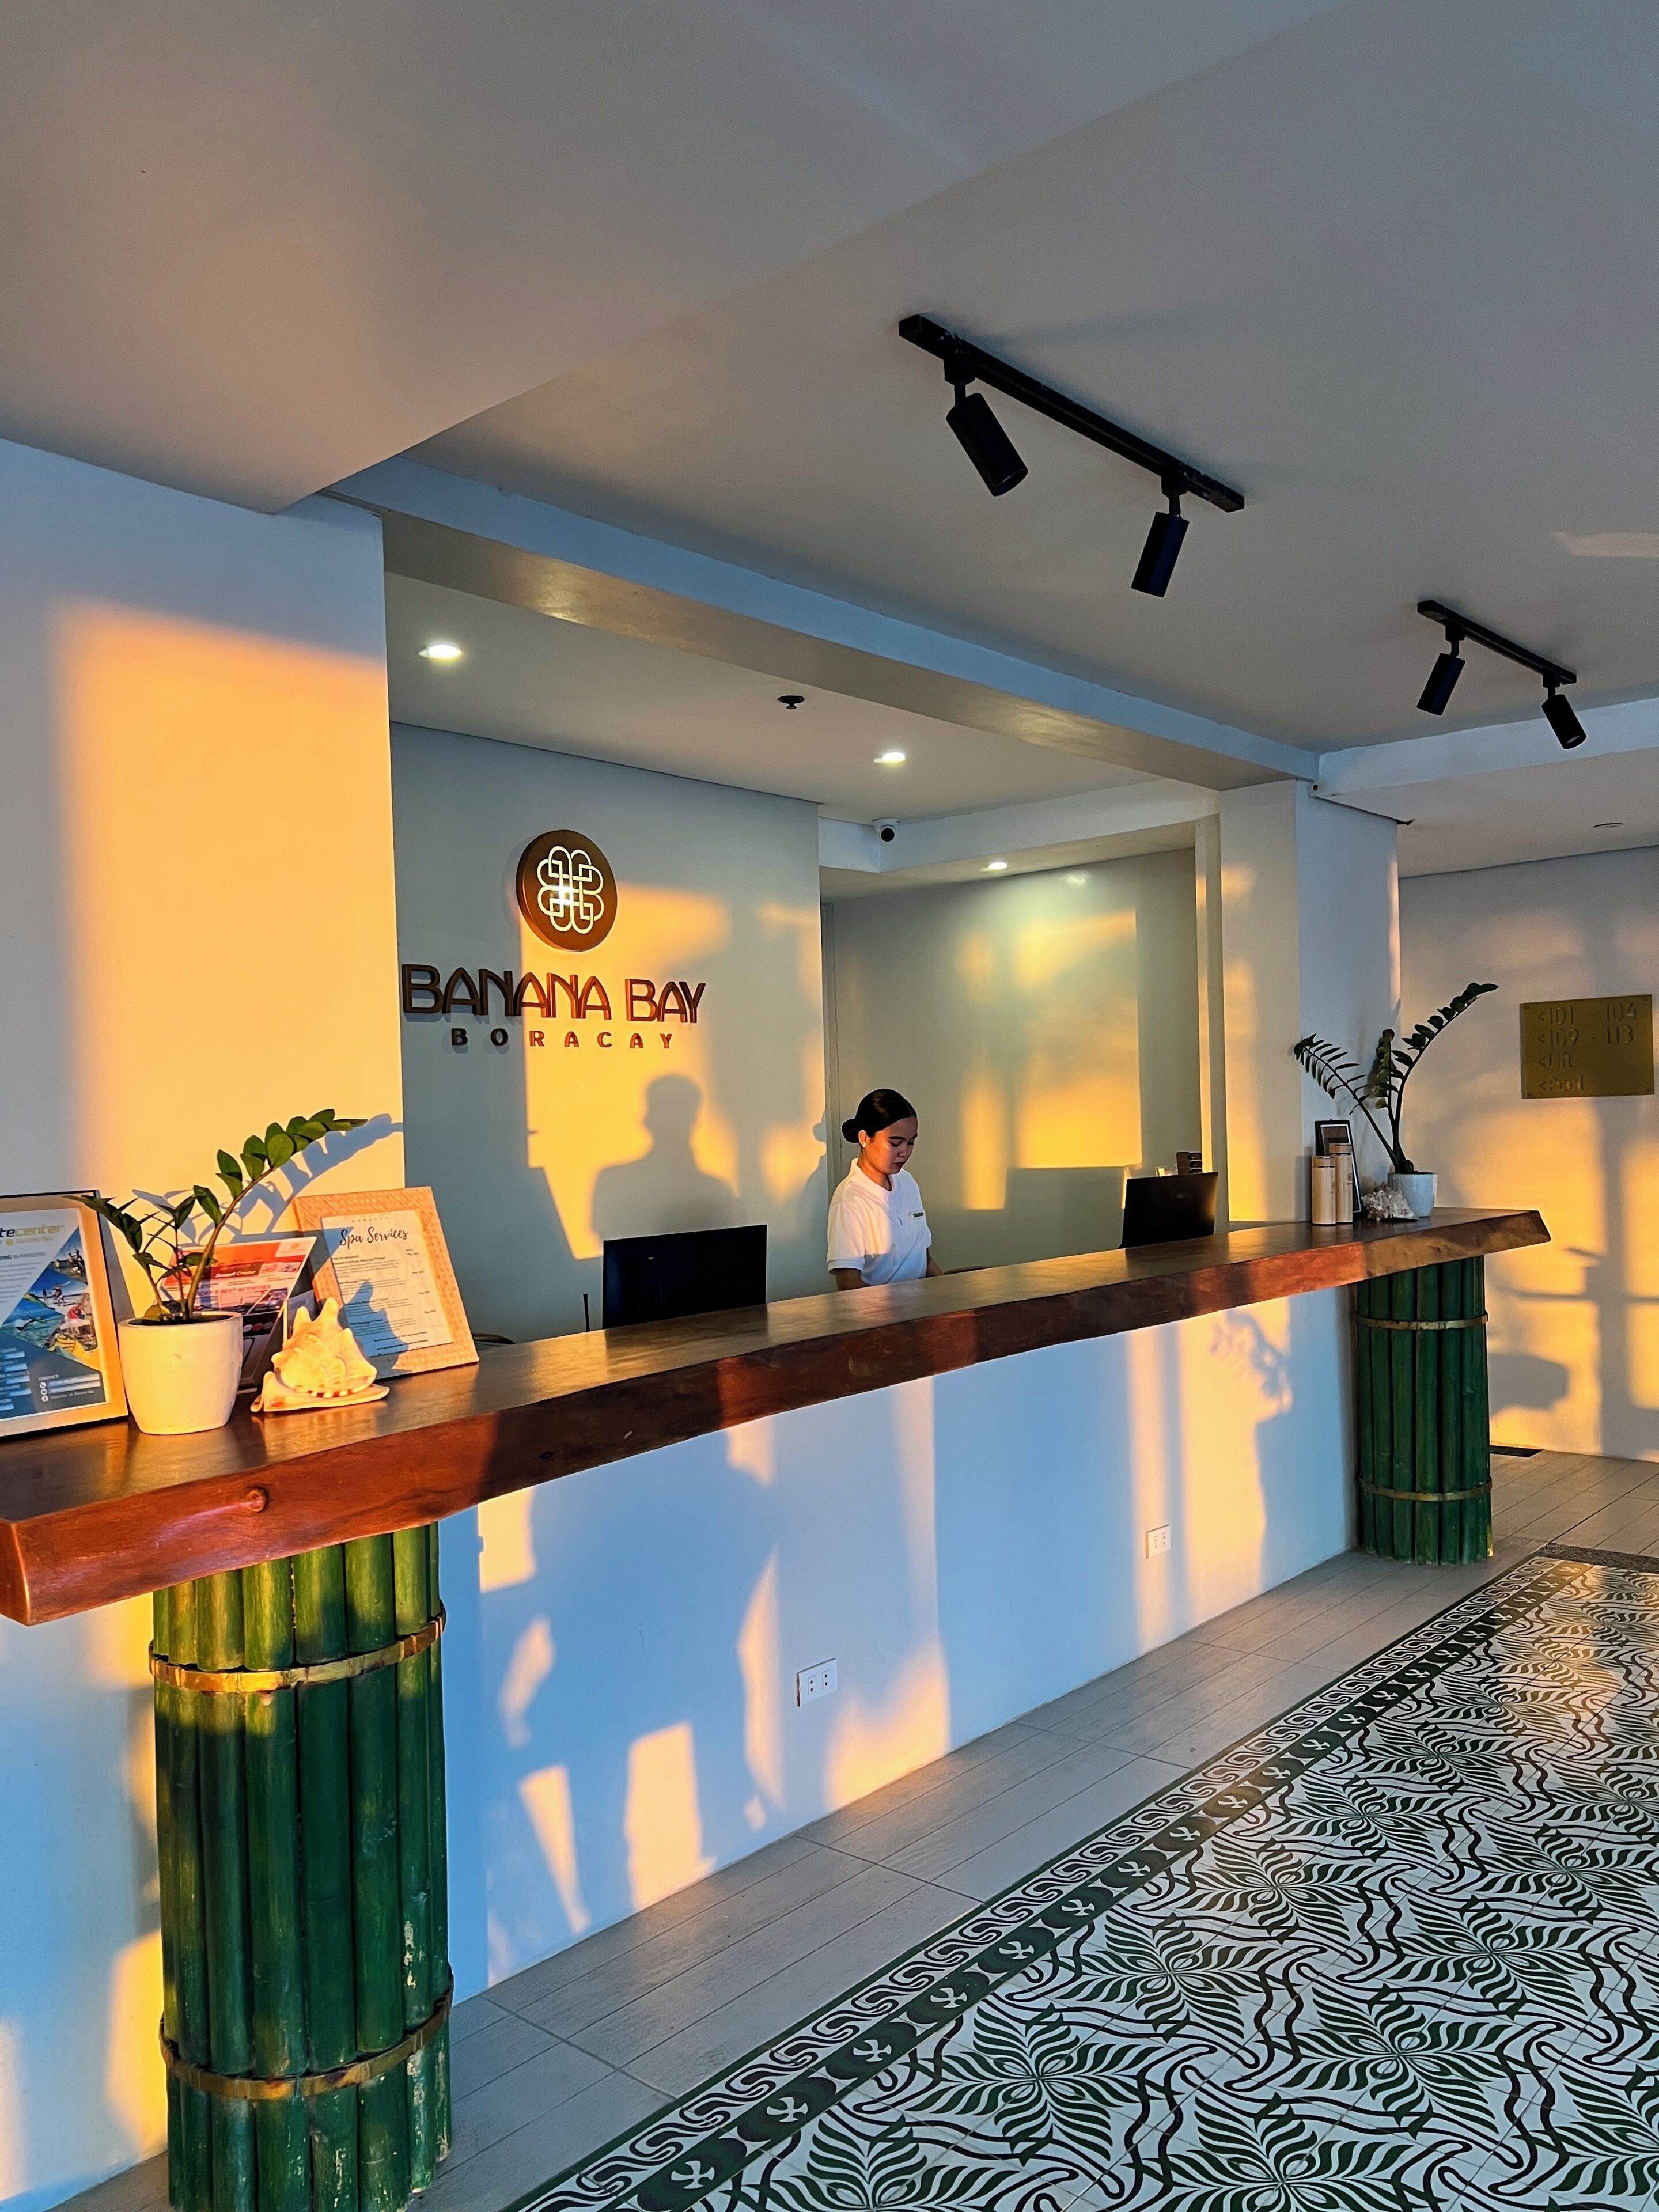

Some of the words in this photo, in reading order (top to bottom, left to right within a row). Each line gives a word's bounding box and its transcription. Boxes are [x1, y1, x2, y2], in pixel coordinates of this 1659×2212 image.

[402, 964, 612, 1020] BANANA
[625, 978, 706, 1024] BAY
[451, 1028, 672, 1050] BORACAY
[339, 1229, 363, 1249] Spa
[366, 1226, 409, 1244] Services
